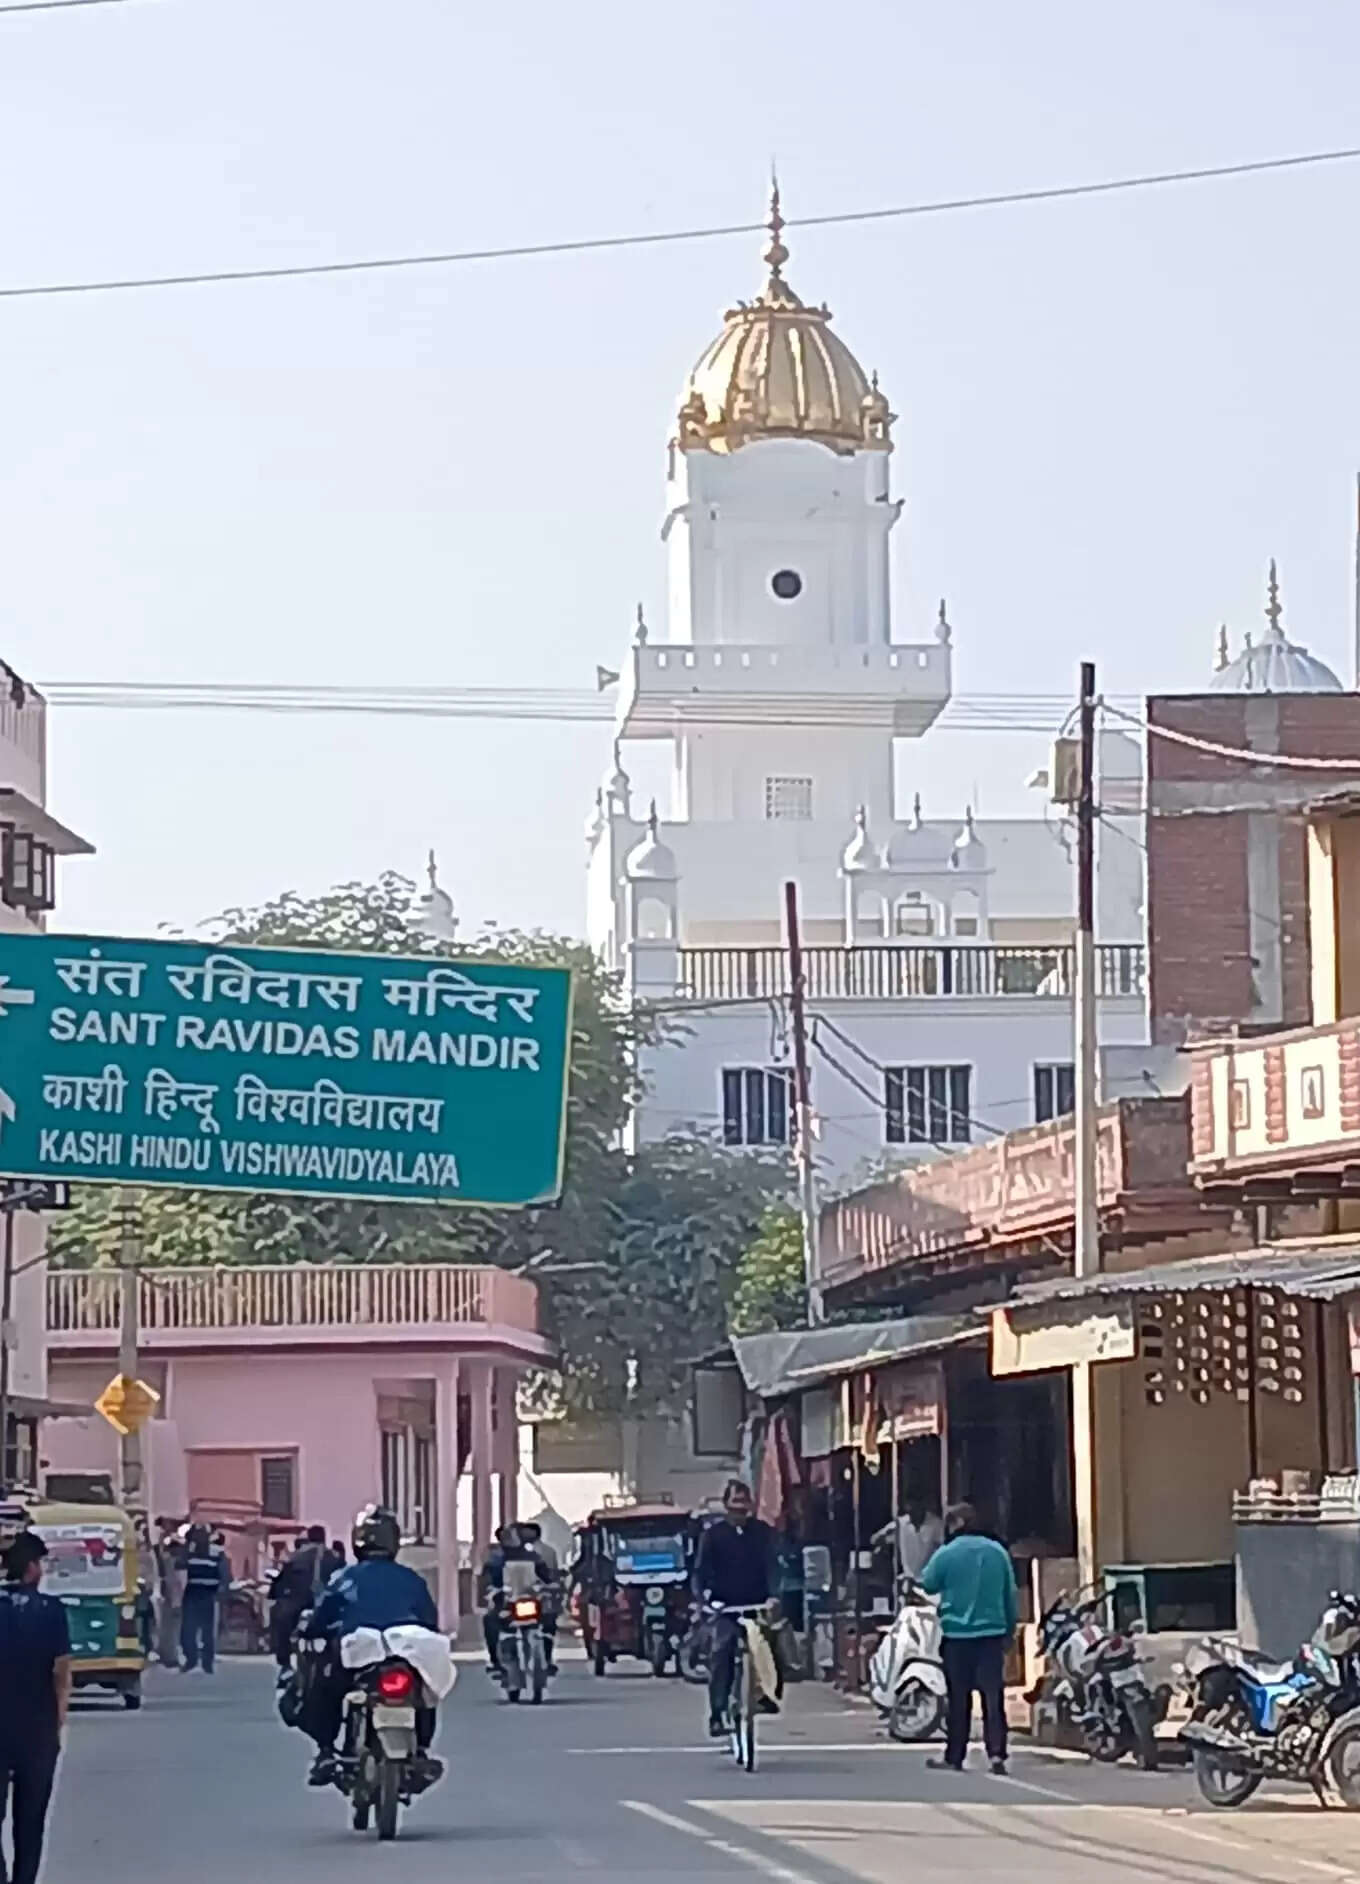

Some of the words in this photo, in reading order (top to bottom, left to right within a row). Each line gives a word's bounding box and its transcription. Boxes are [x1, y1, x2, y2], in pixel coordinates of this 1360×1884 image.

[54, 949, 146, 998] संत
[166, 954, 363, 1012] रविदास
[381, 968, 540, 1023] मन्दिर
[49, 1007, 166, 1046] SANT
[176, 1015, 359, 1059] RAVIDAS
[372, 1028, 540, 1071] MANDIR
[43, 1064, 129, 1114] काशी
[144, 1068, 220, 1134] हिन्दू
[234, 1074, 445, 1133] विश्वविद्यालय
[39, 1129, 122, 1165] KASHI
[130, 1134, 211, 1171] HINDU
[220, 1140, 460, 1187] VISHWAVIDYALAYA
